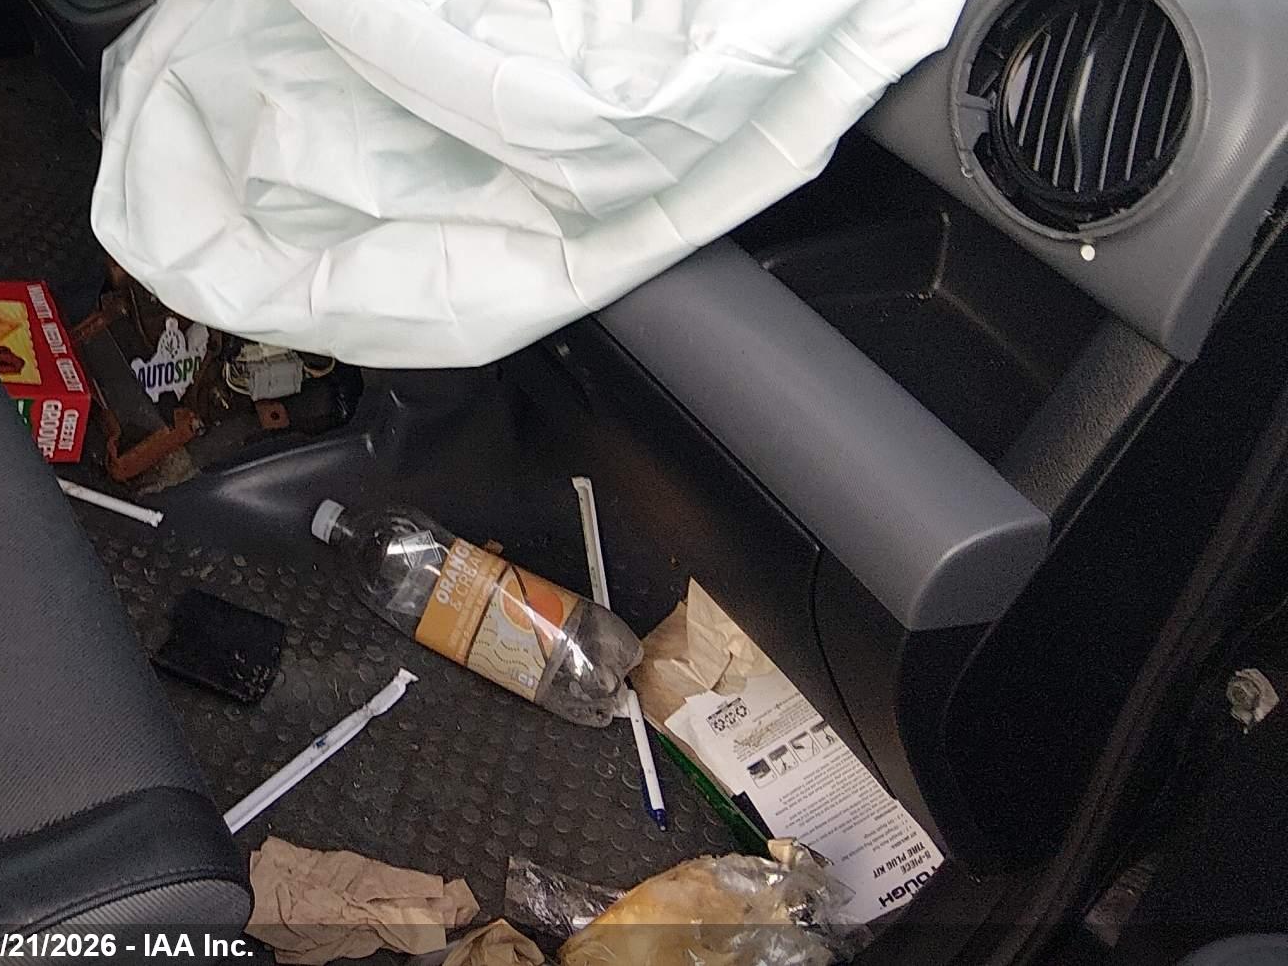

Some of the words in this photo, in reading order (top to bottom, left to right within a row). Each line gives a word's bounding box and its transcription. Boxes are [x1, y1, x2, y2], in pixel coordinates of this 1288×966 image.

[907, 841, 926, 857] TIRE
[885, 852, 907, 872] PLUG
[872, 866, 886, 879] KIT
